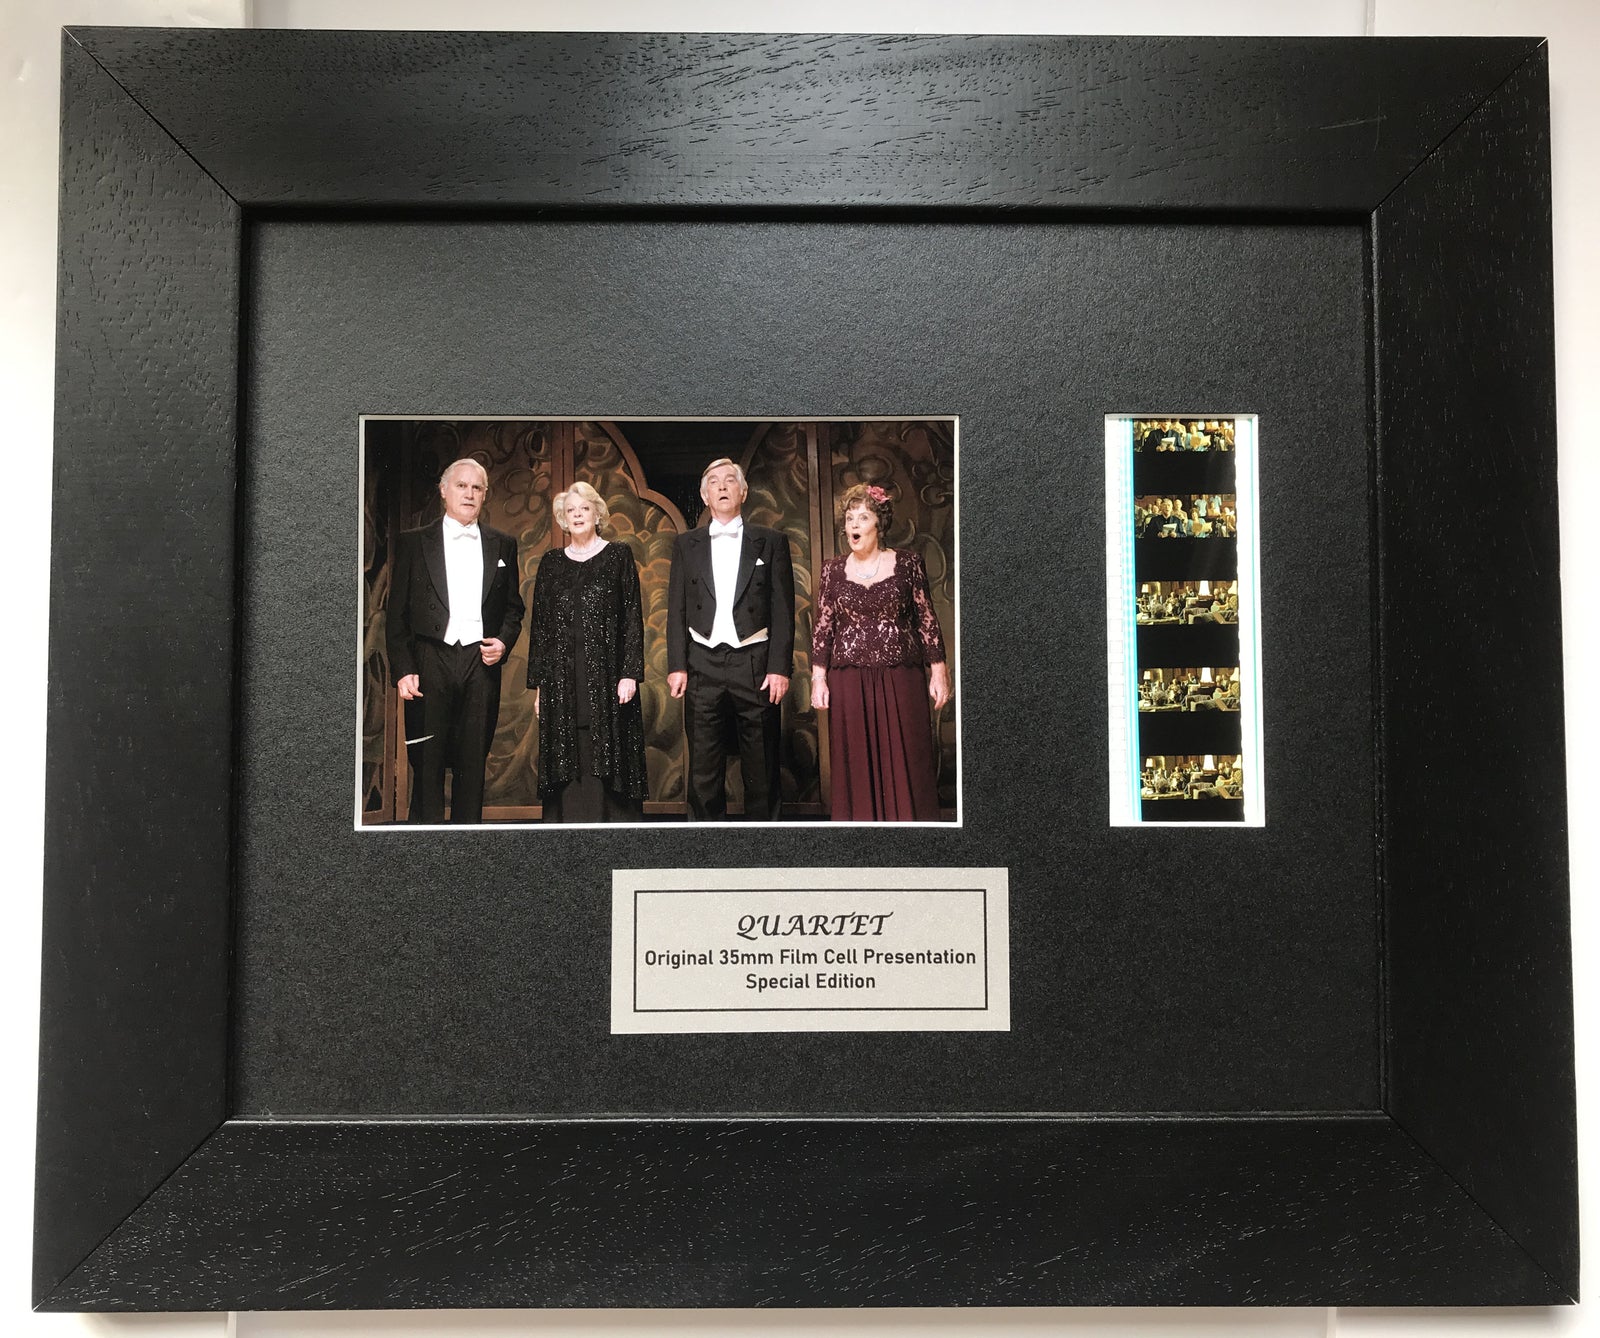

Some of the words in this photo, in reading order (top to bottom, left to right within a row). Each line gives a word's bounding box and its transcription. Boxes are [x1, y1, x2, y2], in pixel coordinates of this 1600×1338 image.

[736, 911, 894, 940] QUARTET
[644, 949, 714, 969] Original
[719, 949, 774, 965] 35mm
[780, 948, 818, 965] Film
[823, 948, 858, 965] Cell
[863, 948, 976, 965] Presentation
[745, 973, 810, 992] Special
[816, 973, 876, 989] Edition
